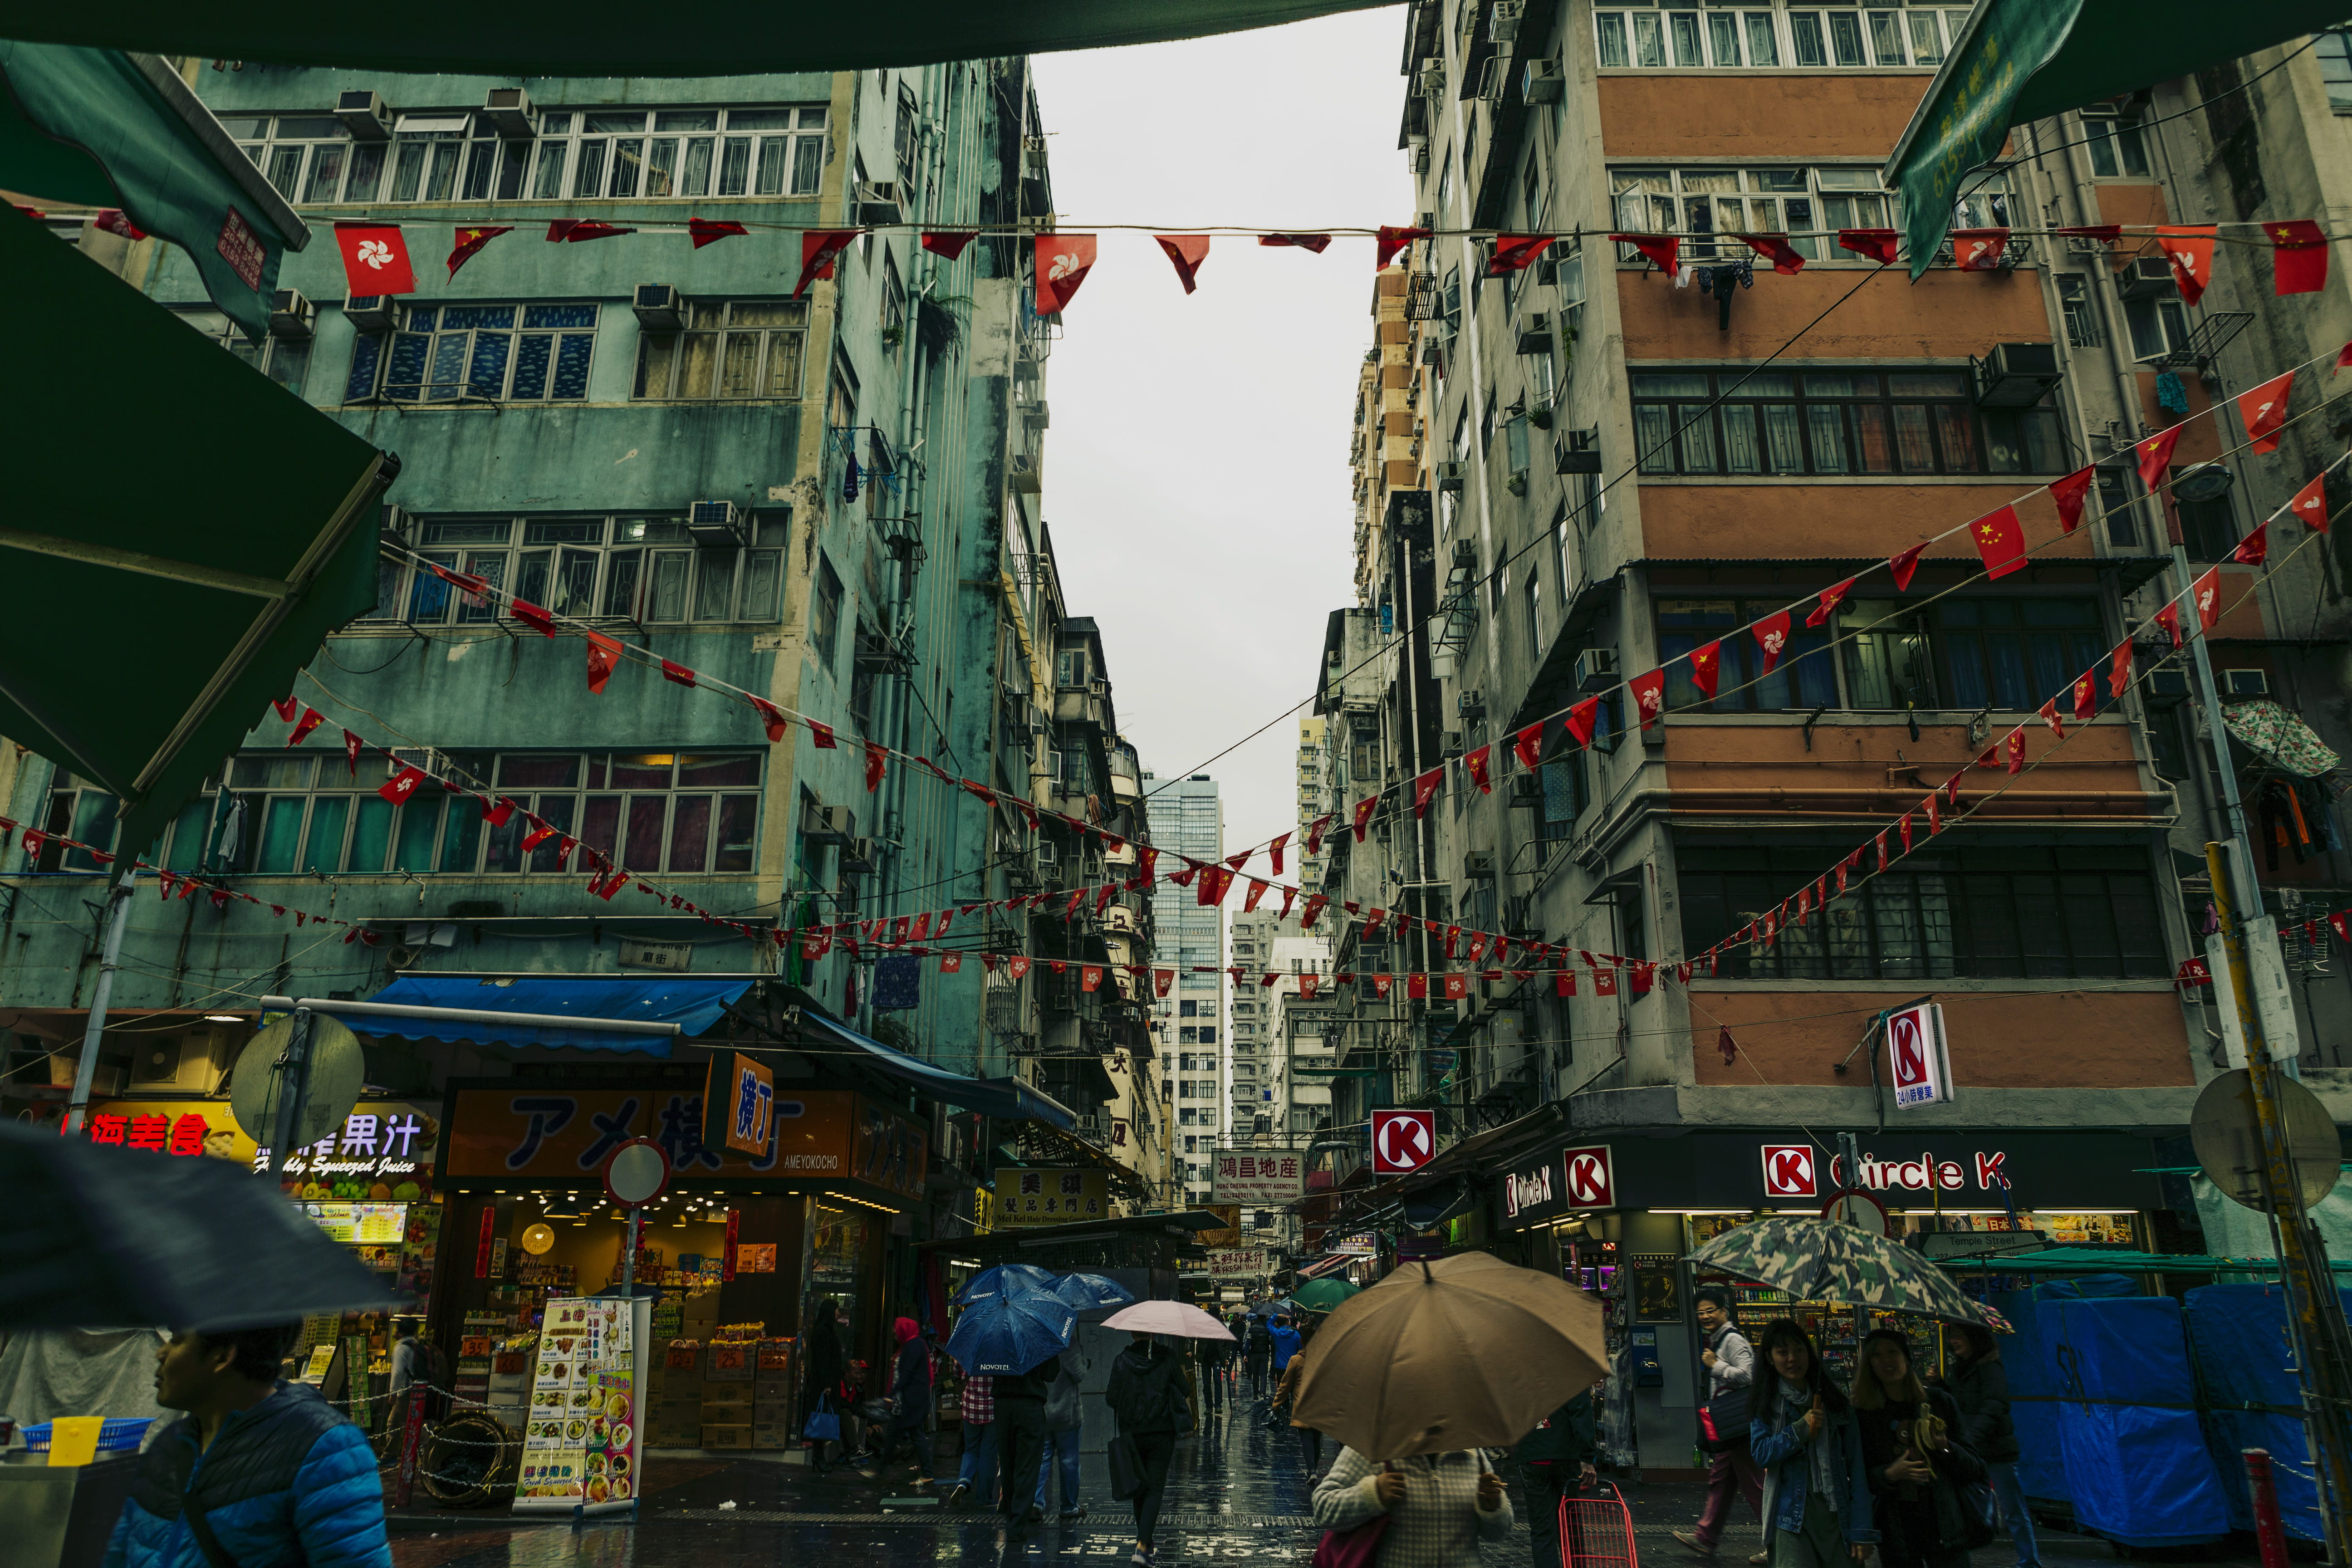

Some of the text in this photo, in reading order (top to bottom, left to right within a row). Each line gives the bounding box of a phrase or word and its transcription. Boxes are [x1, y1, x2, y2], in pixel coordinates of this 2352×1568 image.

[221, 239, 240, 265] 6153
[309, 1156, 375, 1176] Squeezed
[375, 1156, 416, 1177] Juice
[784, 1155, 838, 1170] AMEYOKOCHO
[1518, 1165, 1552, 1209] Circle K
[1004, 1197, 1099, 1213] 髮品專門店
[998, 1215, 1012, 1223] Mei
[1014, 1215, 1025, 1223] Kei
[1042, 1215, 1068, 1224] Dressing
[1949, 1235, 2016, 1247] Temple Street
[1222, 1264, 1242, 1274] FRESH
[1061, 1317, 1073, 1338] NOVOTEL
[523, 1476, 543, 1488] Fresh
[544, 1476, 573, 1487] Squeezed
